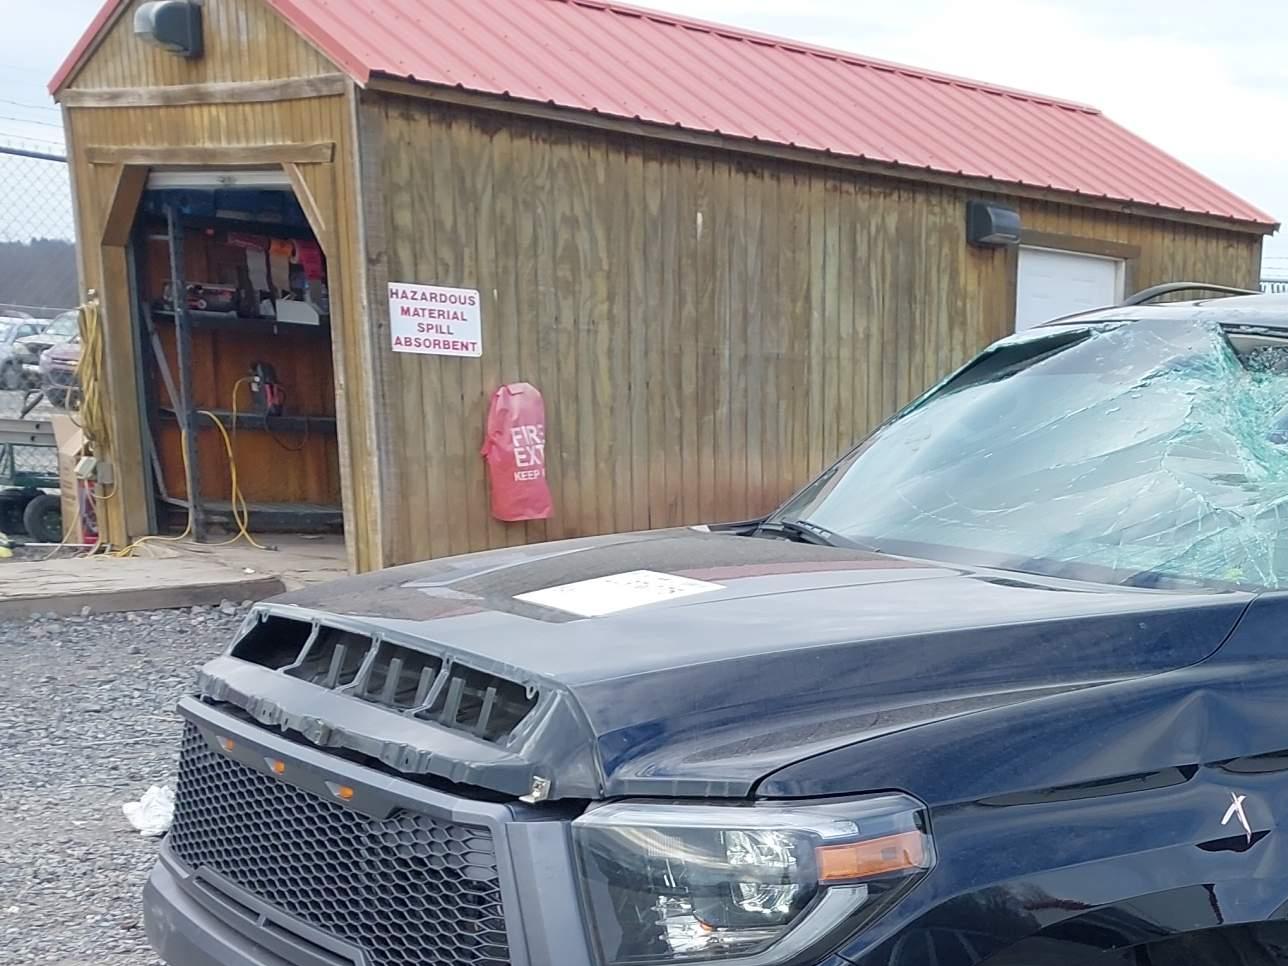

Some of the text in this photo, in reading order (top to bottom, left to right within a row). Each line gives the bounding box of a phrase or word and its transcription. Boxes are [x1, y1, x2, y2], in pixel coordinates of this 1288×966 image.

[390, 288, 476, 306] HAZARDOUS
[400, 306, 468, 321] MATERIAL
[417, 323, 454, 335] SPILL
[394, 336, 477, 352] ABSORBENT
[514, 470, 540, 481] KEEP
